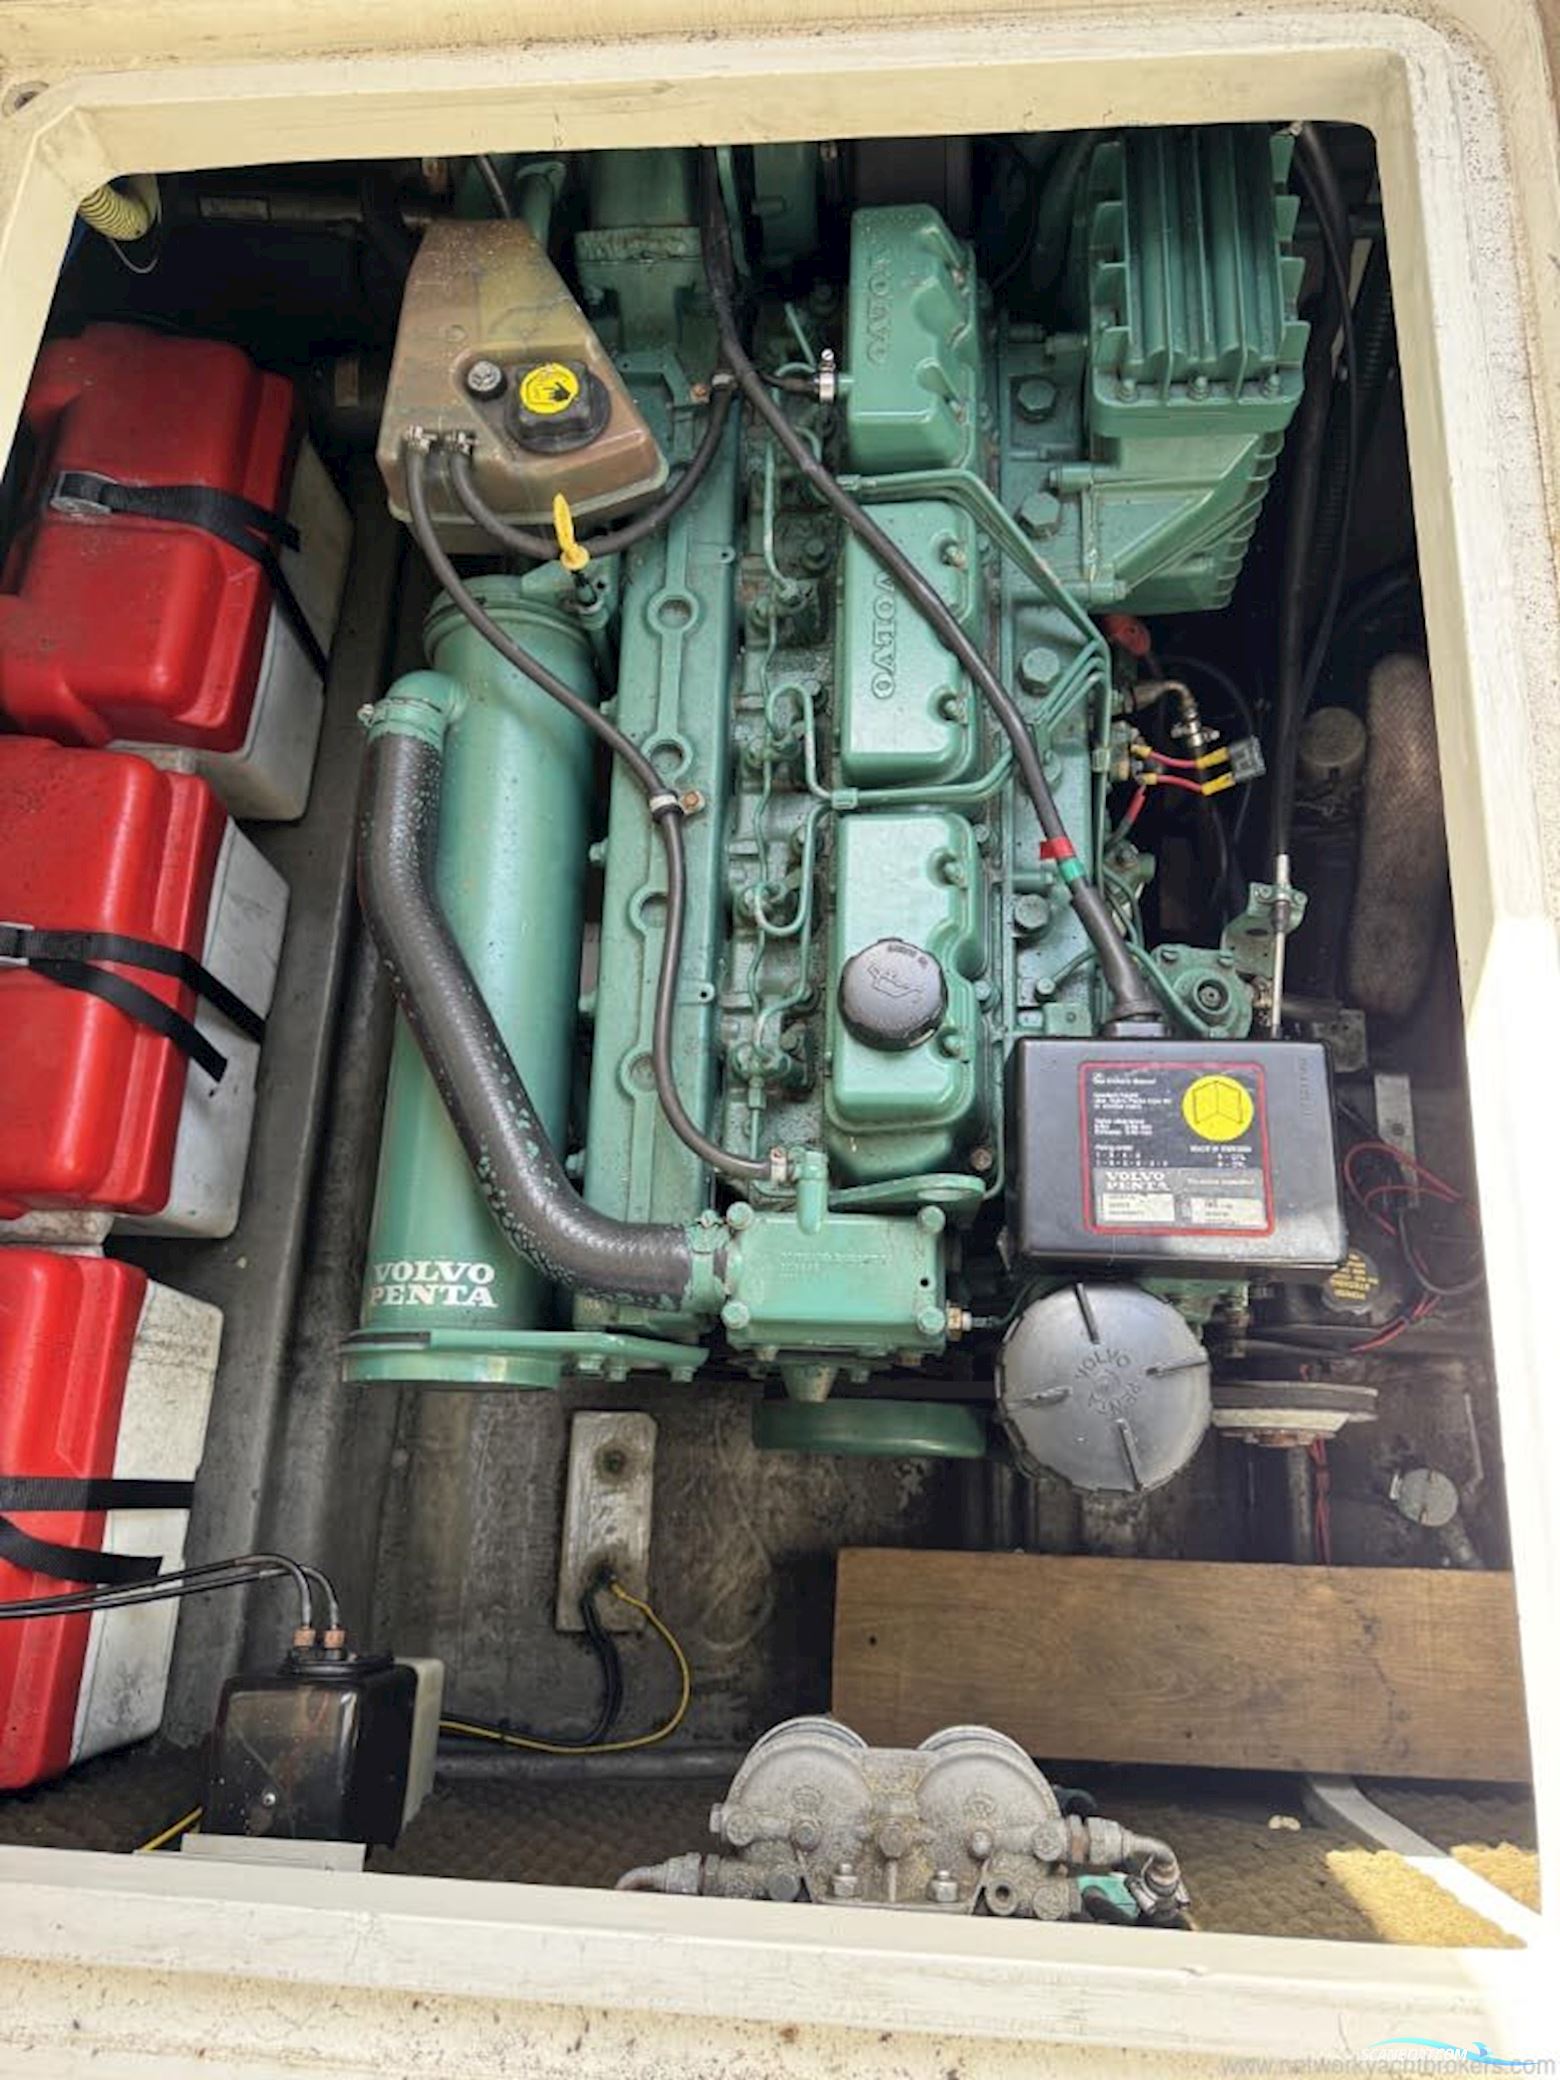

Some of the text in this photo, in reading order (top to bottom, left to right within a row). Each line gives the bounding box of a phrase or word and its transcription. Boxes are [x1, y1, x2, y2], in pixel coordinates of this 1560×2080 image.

[866, 250, 893, 364] VOLVO
[871, 568, 896, 700] VOLVO
[1105, 1171, 1165, 1181] VOLVO
[1106, 1181, 1171, 1191] PENTA
[374, 1259, 495, 1284] VOLVO
[369, 1284, 499, 1308] PENTA
[1074, 1348, 1131, 1379] VOLVO
